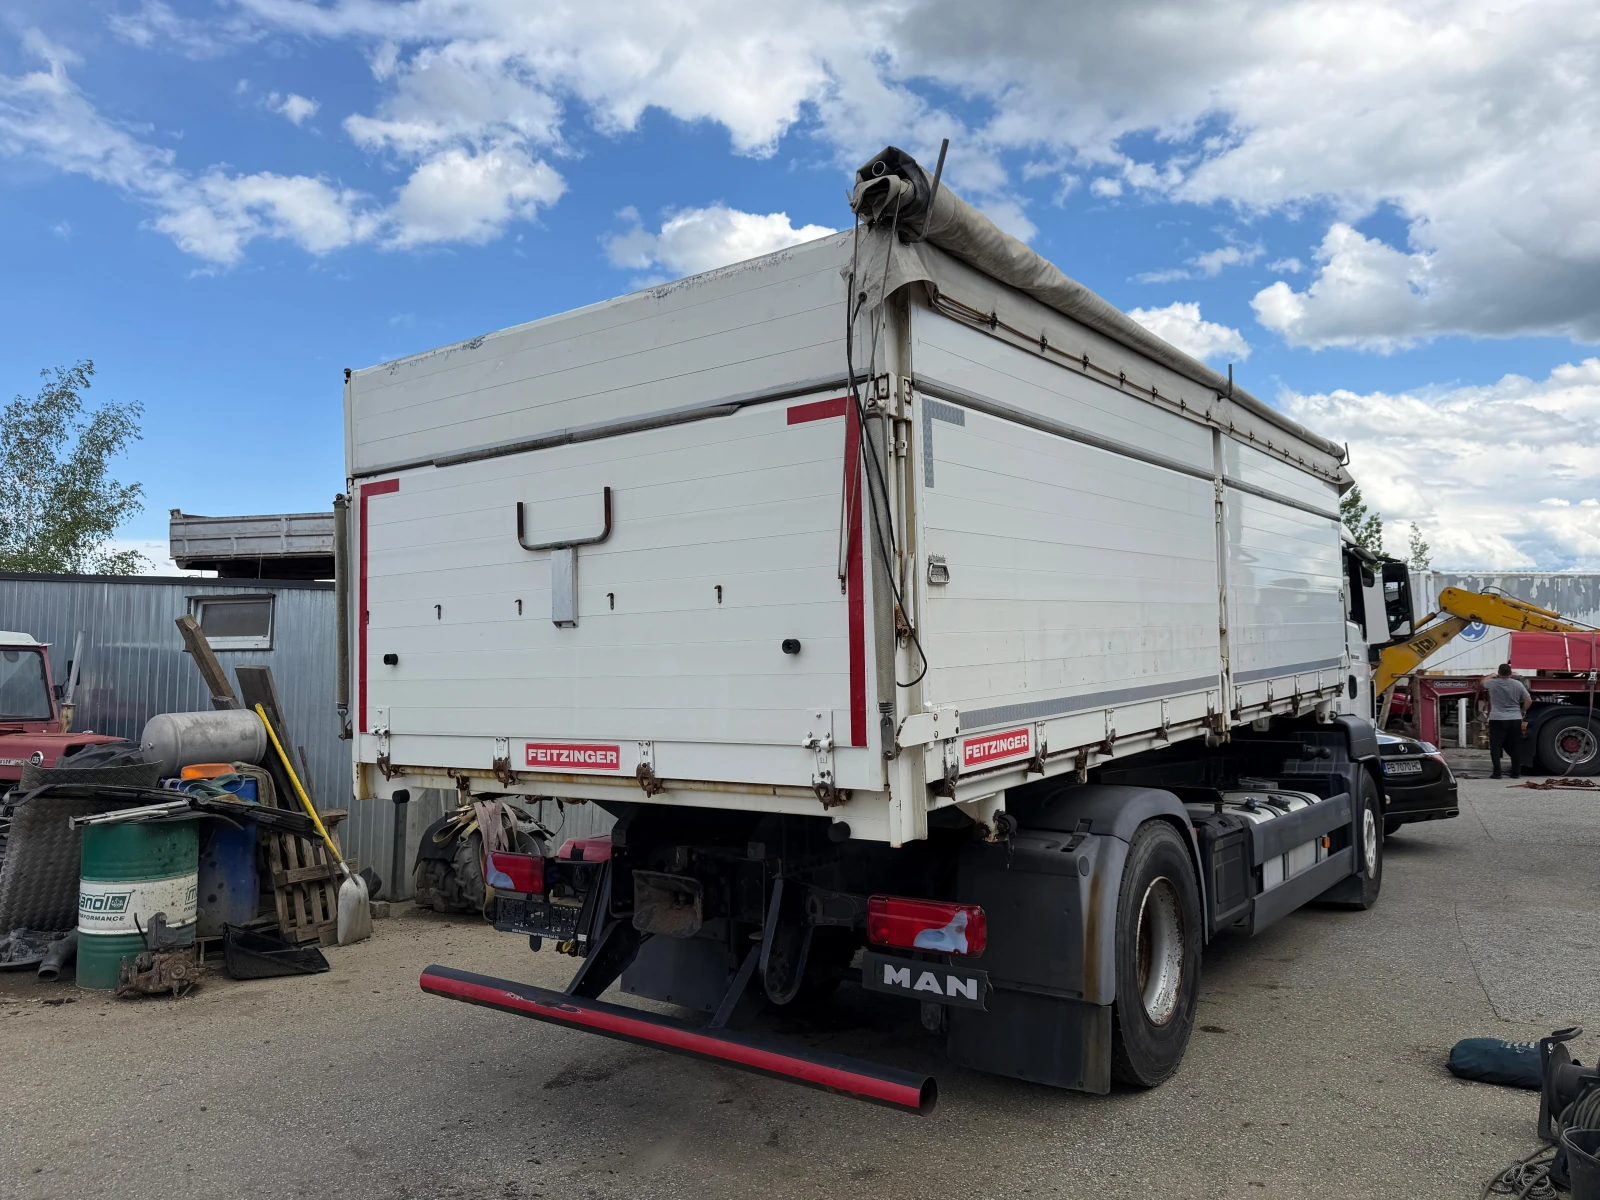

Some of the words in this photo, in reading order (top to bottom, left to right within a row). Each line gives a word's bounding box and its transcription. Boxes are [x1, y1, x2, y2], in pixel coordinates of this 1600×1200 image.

[1412, 638, 1435, 656] JCB
[527, 748, 617, 764] FEITZINGER
[965, 734, 1028, 760] FEITZINGER
[883, 963, 978, 1000] MAN
